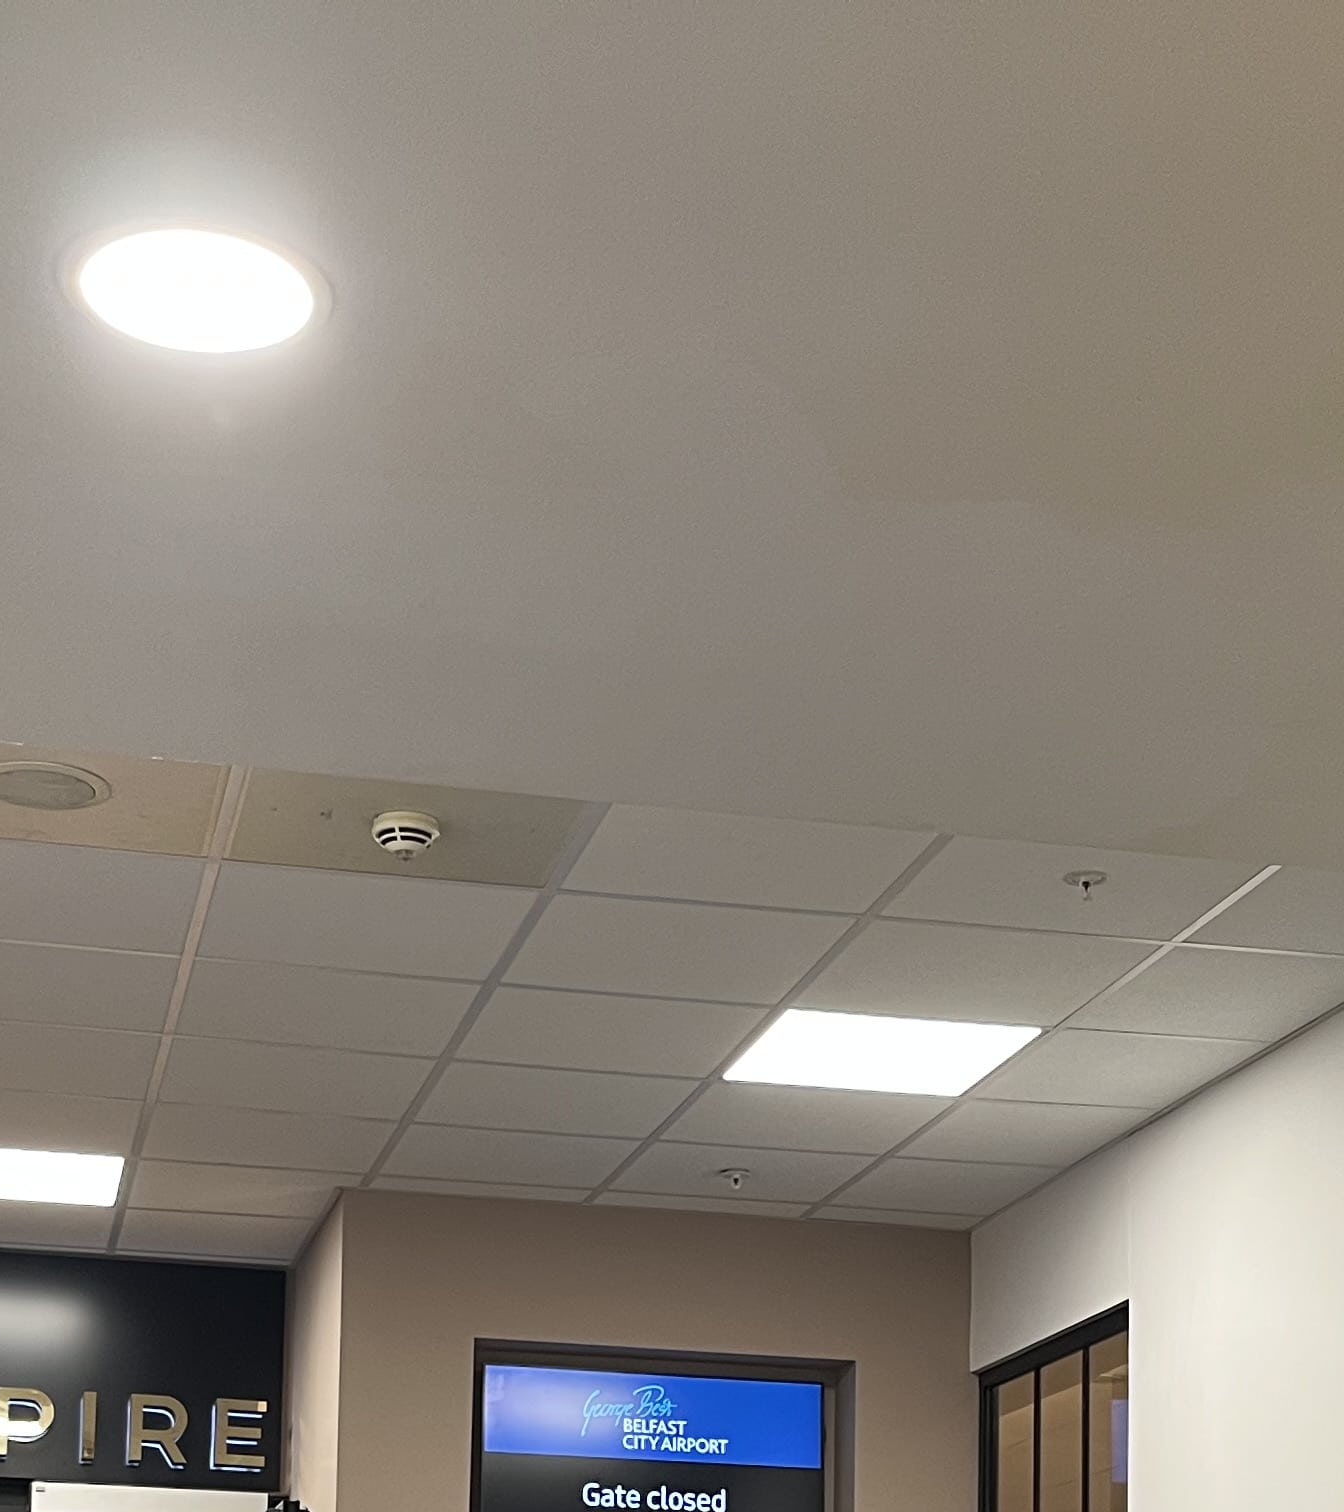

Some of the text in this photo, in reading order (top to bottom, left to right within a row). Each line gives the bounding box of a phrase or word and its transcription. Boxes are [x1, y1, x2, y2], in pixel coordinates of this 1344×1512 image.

[580, 1384, 678, 1437] George Best
[623, 1418, 688, 1436] BELFAST
[622, 1435, 729, 1455] CITY AIRPORT
[582, 1482, 727, 1512] Gate closed
